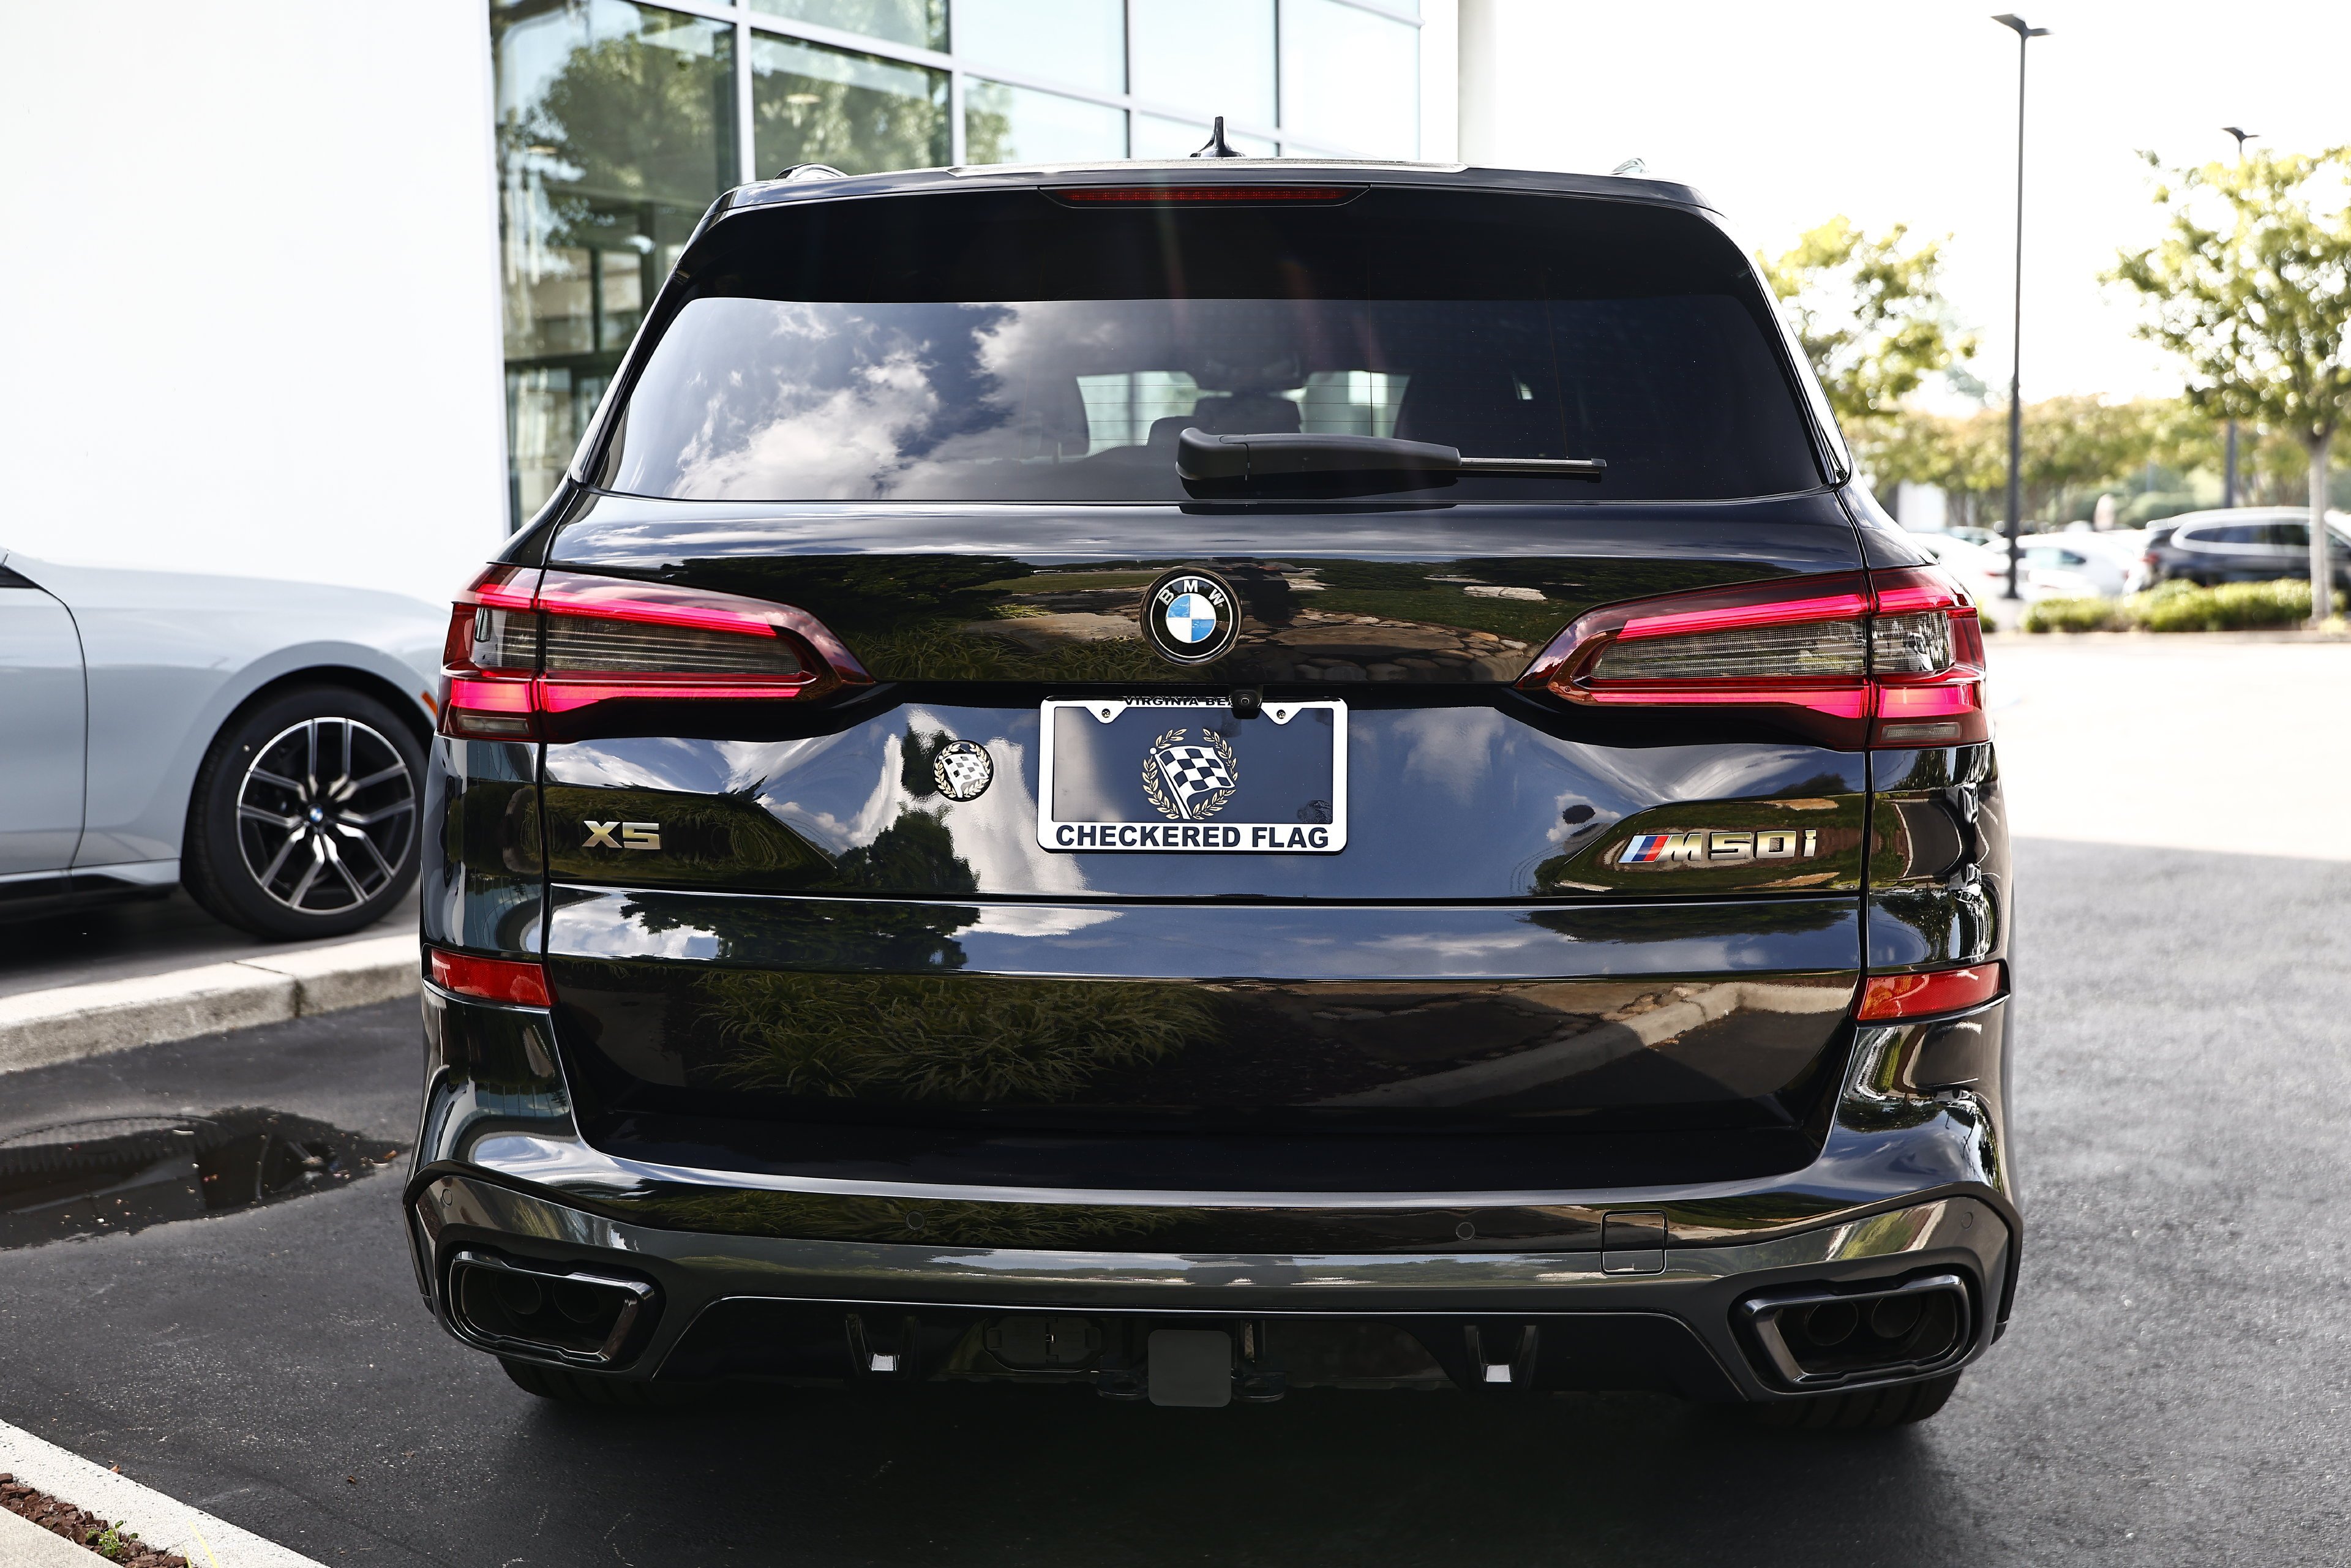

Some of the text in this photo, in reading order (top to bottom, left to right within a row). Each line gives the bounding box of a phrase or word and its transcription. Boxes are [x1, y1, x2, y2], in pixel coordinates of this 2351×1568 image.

[1158, 580, 1224, 607] BMW
[1124, 696, 1199, 706] VIRGINIA
[582, 820, 661, 850] X5
[1056, 825, 1329, 849] CHECKERED FLAG
[1654, 830, 1817, 861] M50i
